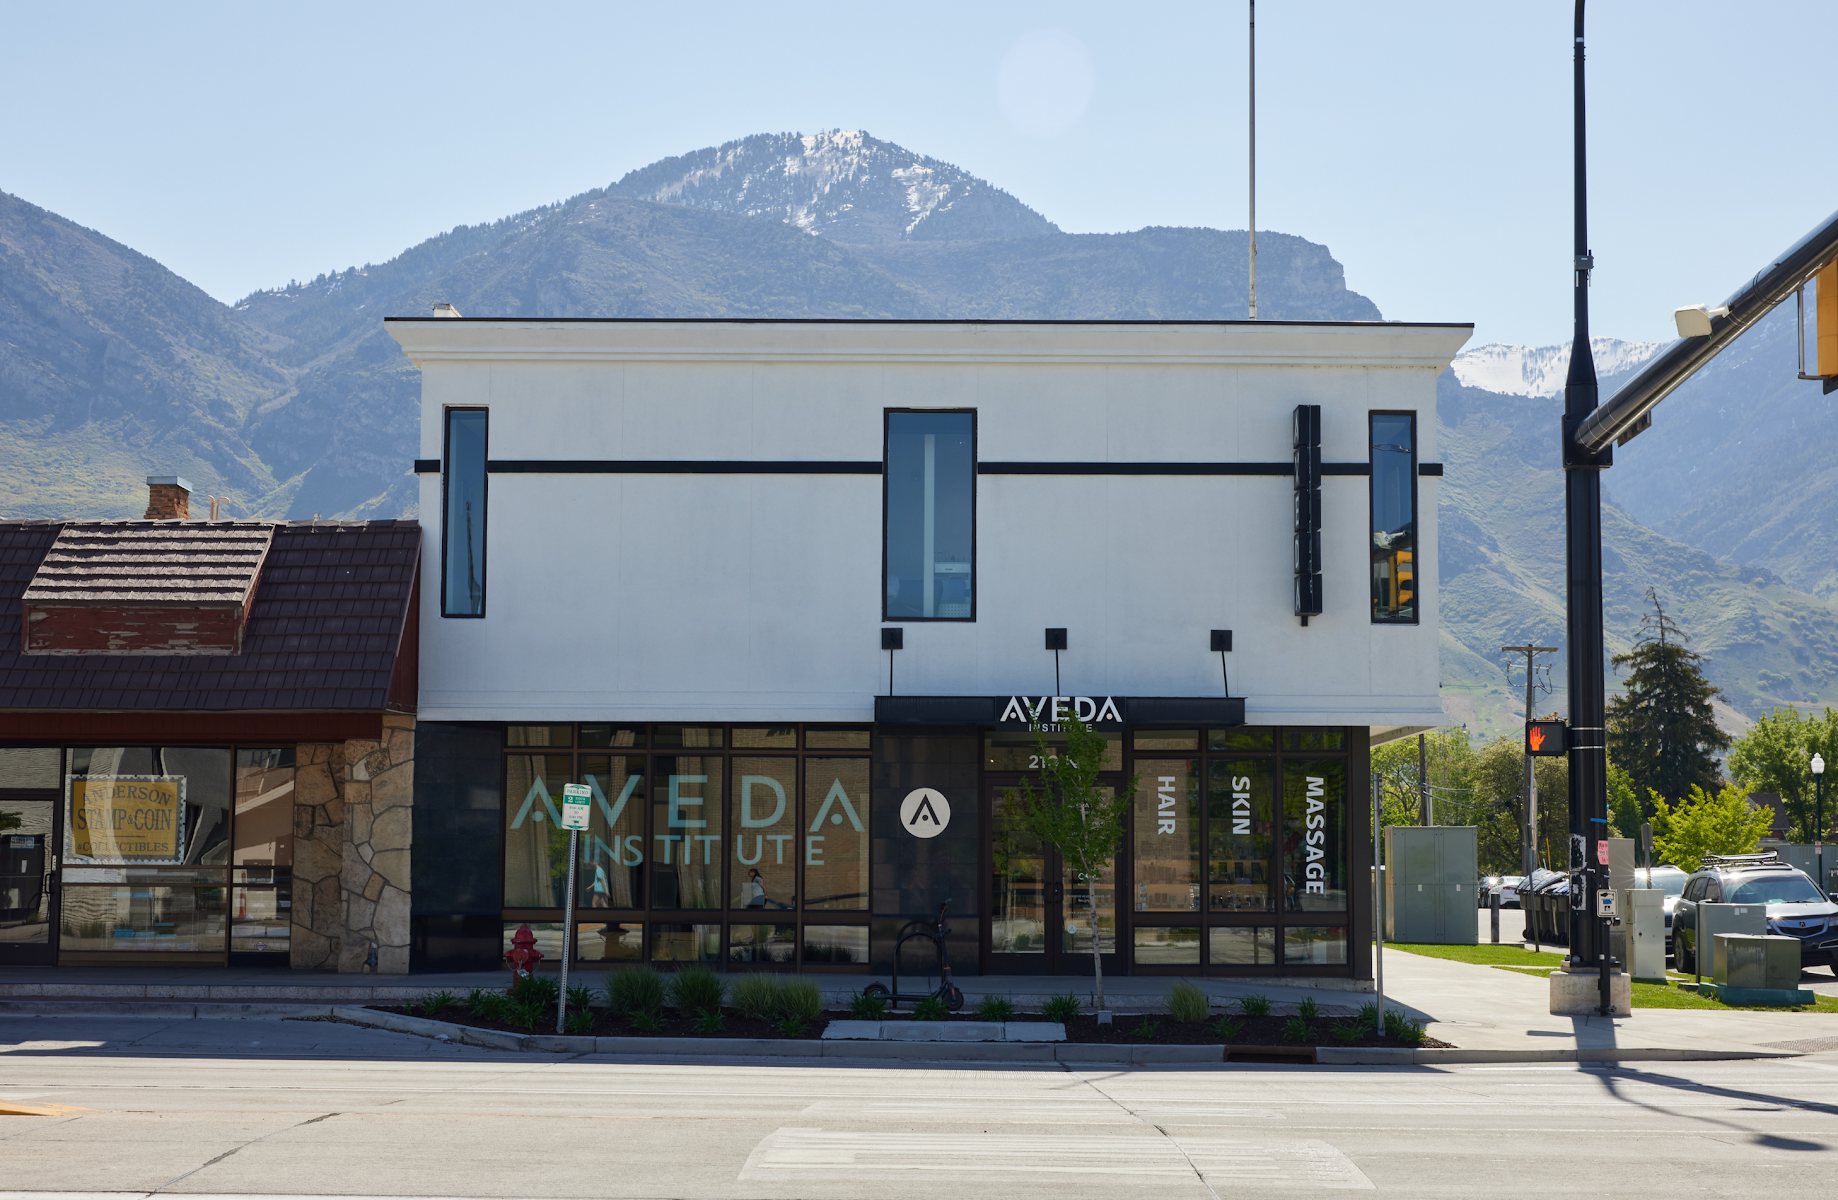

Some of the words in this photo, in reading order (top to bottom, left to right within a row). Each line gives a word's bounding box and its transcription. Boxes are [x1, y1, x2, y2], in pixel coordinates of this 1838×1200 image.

[1000, 695, 1123, 722] AVEDA
[82, 785, 173, 807] ANDERSON
[509, 774, 866, 832] AVEDA
[1157, 776, 1176, 835] HAIR
[1232, 776, 1250, 835] SKIN
[77, 808, 127, 831] STAMP
[134, 808, 173, 831] COIN
[1305, 776, 1325, 894] MASSAGE
[82, 842, 169, 852] COLLECTIBLES
[583, 834, 825, 867] INSTITUTE
